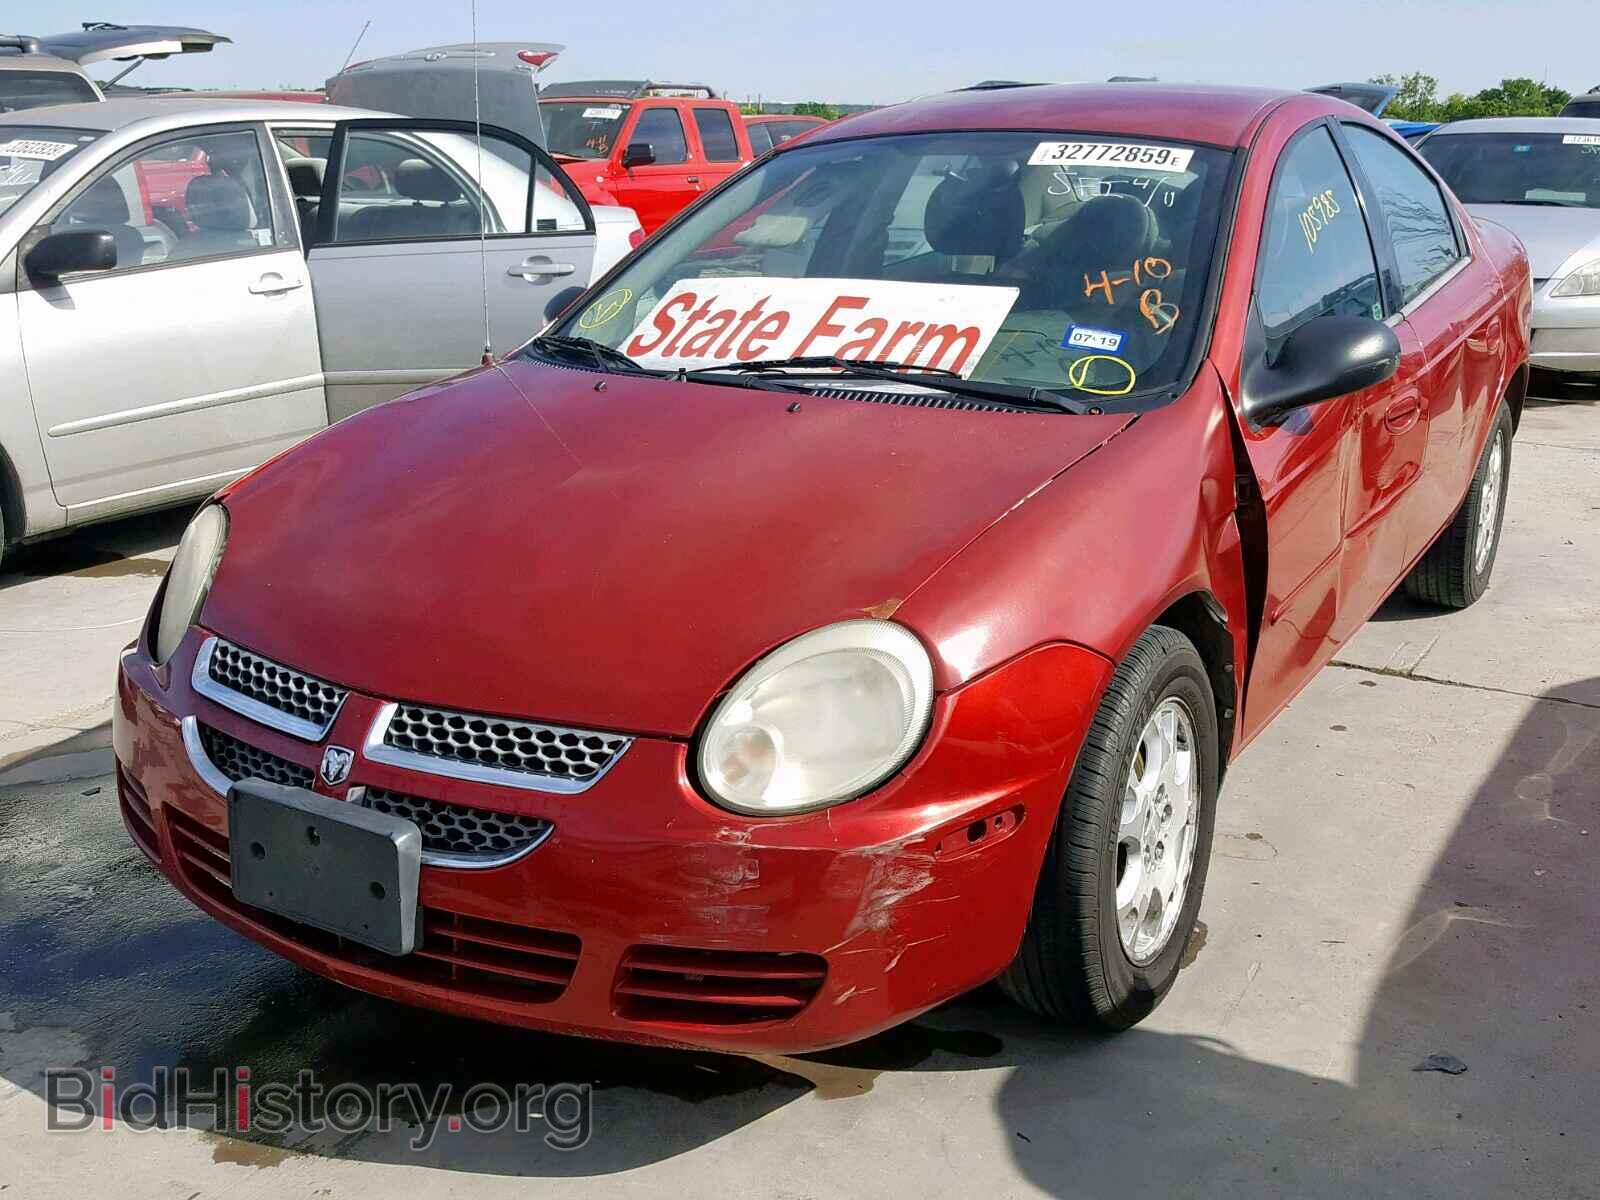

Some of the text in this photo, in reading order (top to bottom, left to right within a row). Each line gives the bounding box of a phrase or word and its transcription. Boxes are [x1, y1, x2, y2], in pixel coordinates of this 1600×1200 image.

[1052, 144, 1171, 165] 32772859
[627, 290, 791, 362] State
[790, 295, 982, 376] Farm
